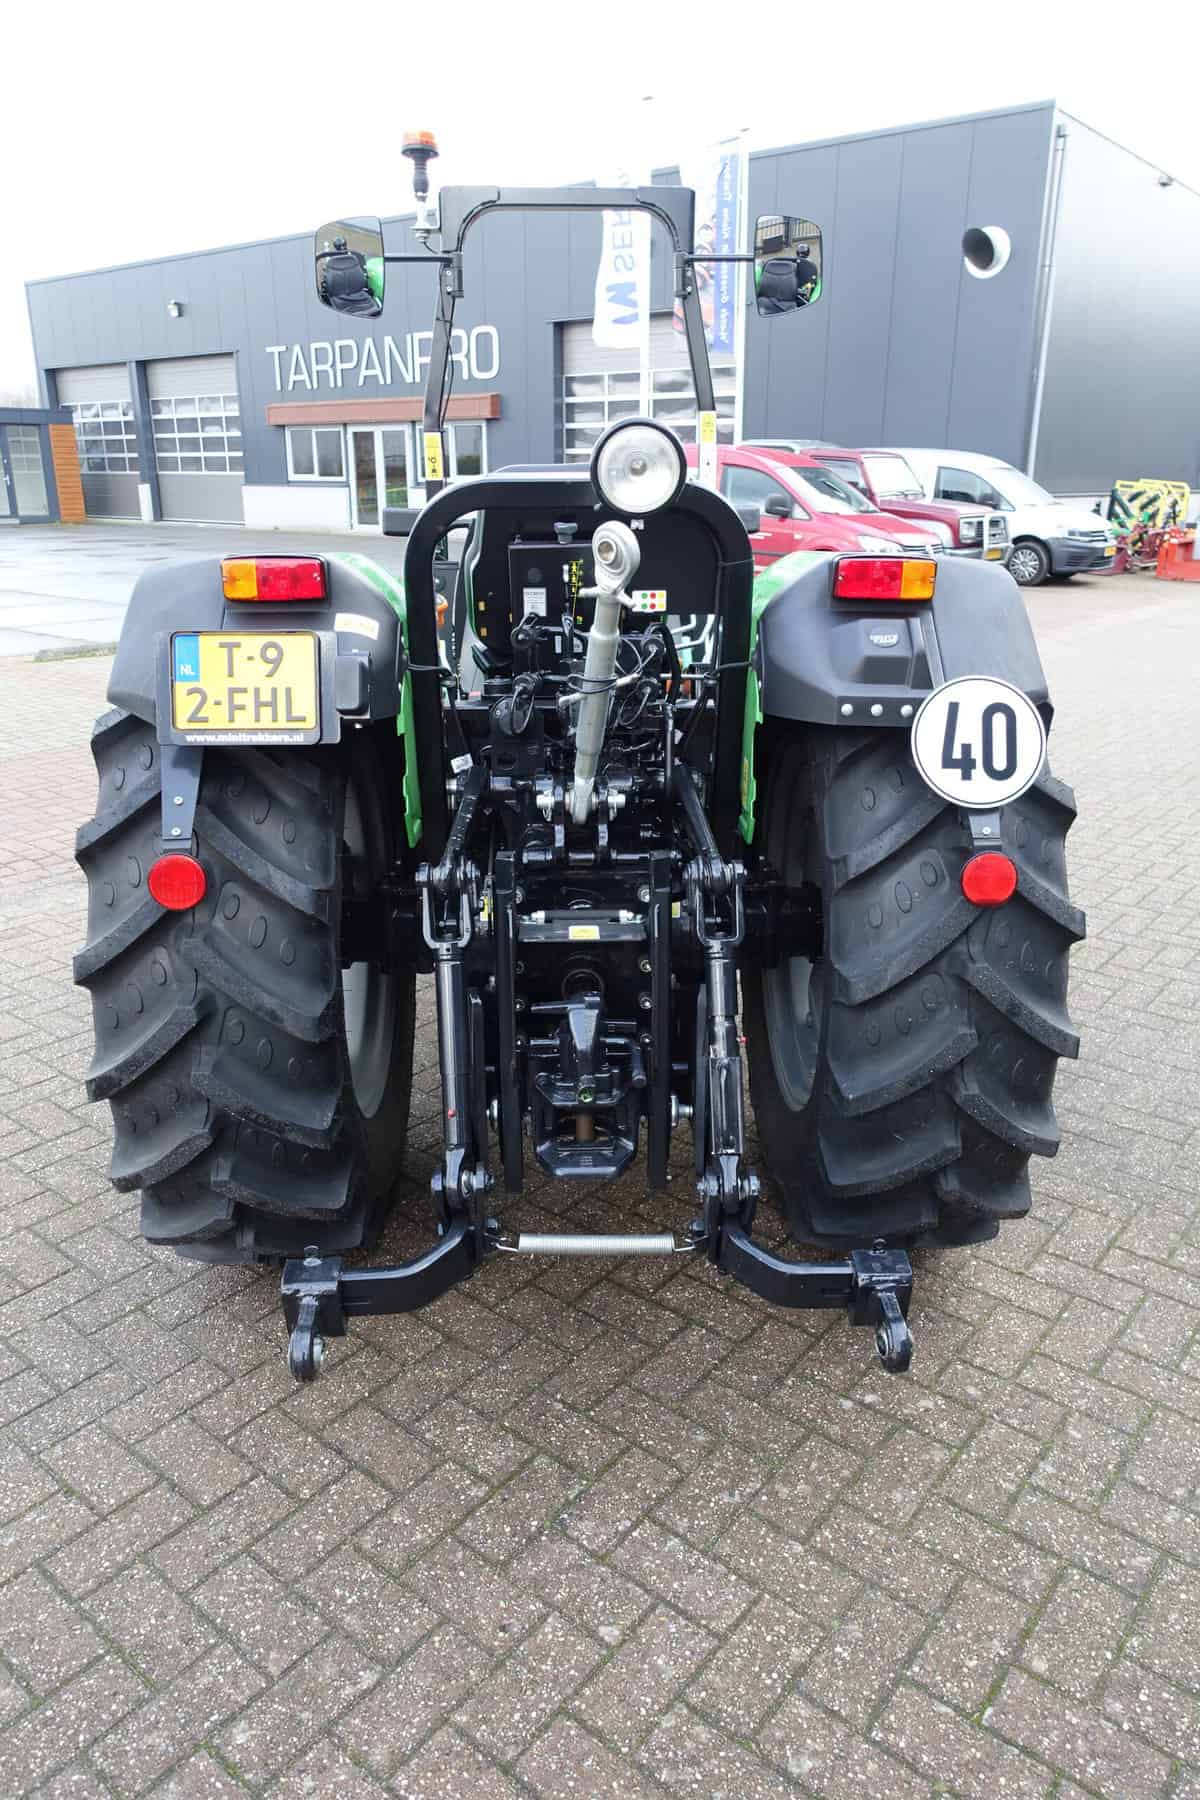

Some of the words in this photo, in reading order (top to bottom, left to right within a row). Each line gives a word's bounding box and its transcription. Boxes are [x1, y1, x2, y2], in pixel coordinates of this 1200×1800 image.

[180, 665, 195, 676] NL
[218, 641, 284, 677] T-9
[186, 687, 307, 723] 2-FHL
[941, 701, 1018, 781] 40
